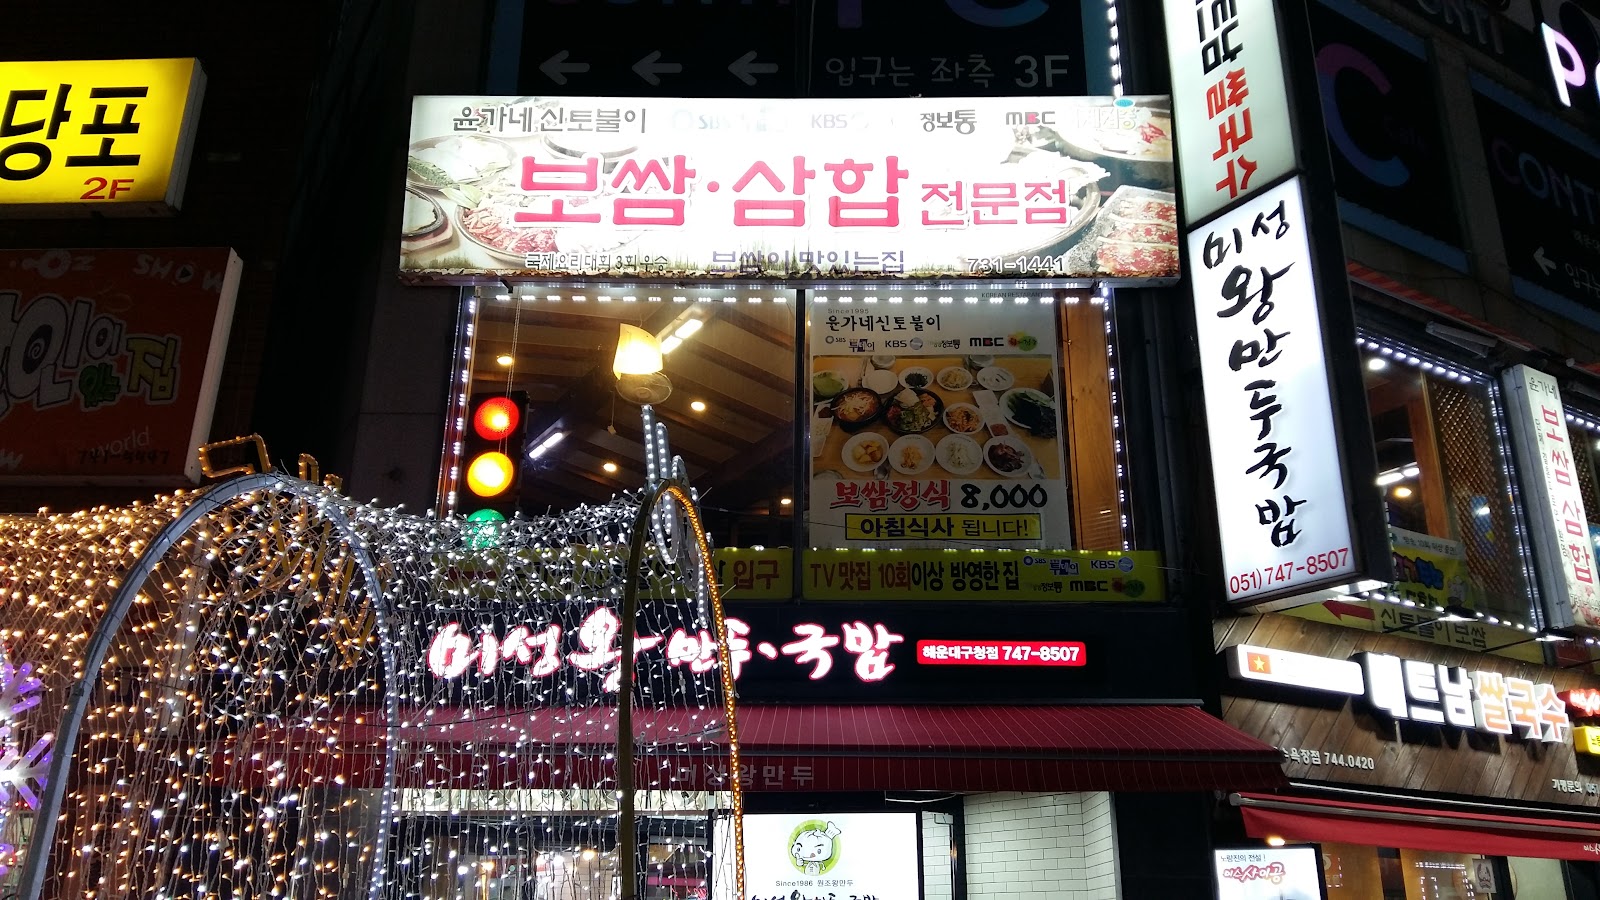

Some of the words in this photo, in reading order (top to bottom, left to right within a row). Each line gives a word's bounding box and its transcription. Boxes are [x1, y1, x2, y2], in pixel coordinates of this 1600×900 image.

[825, 56, 915, 88] 입구는
[930, 55, 994, 88] 좌측
[1014, 54, 1069, 89] 3F
[1196, 0, 1258, 199] 트남쌀국수
[80, 177, 135, 200] 2F
[513, 154, 909, 227] 보쌈·삼합
[920, 180, 1068, 226] 전문점
[616, 254, 637, 271] 3회
[640, 254, 668, 272] 우승
[967, 256, 1065, 274] 731-1441
[825, 315, 941, 332] 윤가네신토불이
[885, 340, 907, 348] KBS
[830, 480, 951, 512] 보쌈정식
[960, 484, 1048, 511] 8,000
[859, 516, 954, 539] 아침식사
[961, 517, 1028, 538] 됩니다!
[732, 557, 780, 590] 입구
[810, 563, 835, 589] TV
[839, 561, 872, 591] 맛집
[1091, 560, 1115, 569] KBS
[922, 645, 999, 661] 해운대구청점
[1002, 645, 1080, 662] 747-8507
[1365, 652, 1568, 742] 트남쌀국수
[1323, 752, 1375, 770] 744.0420
